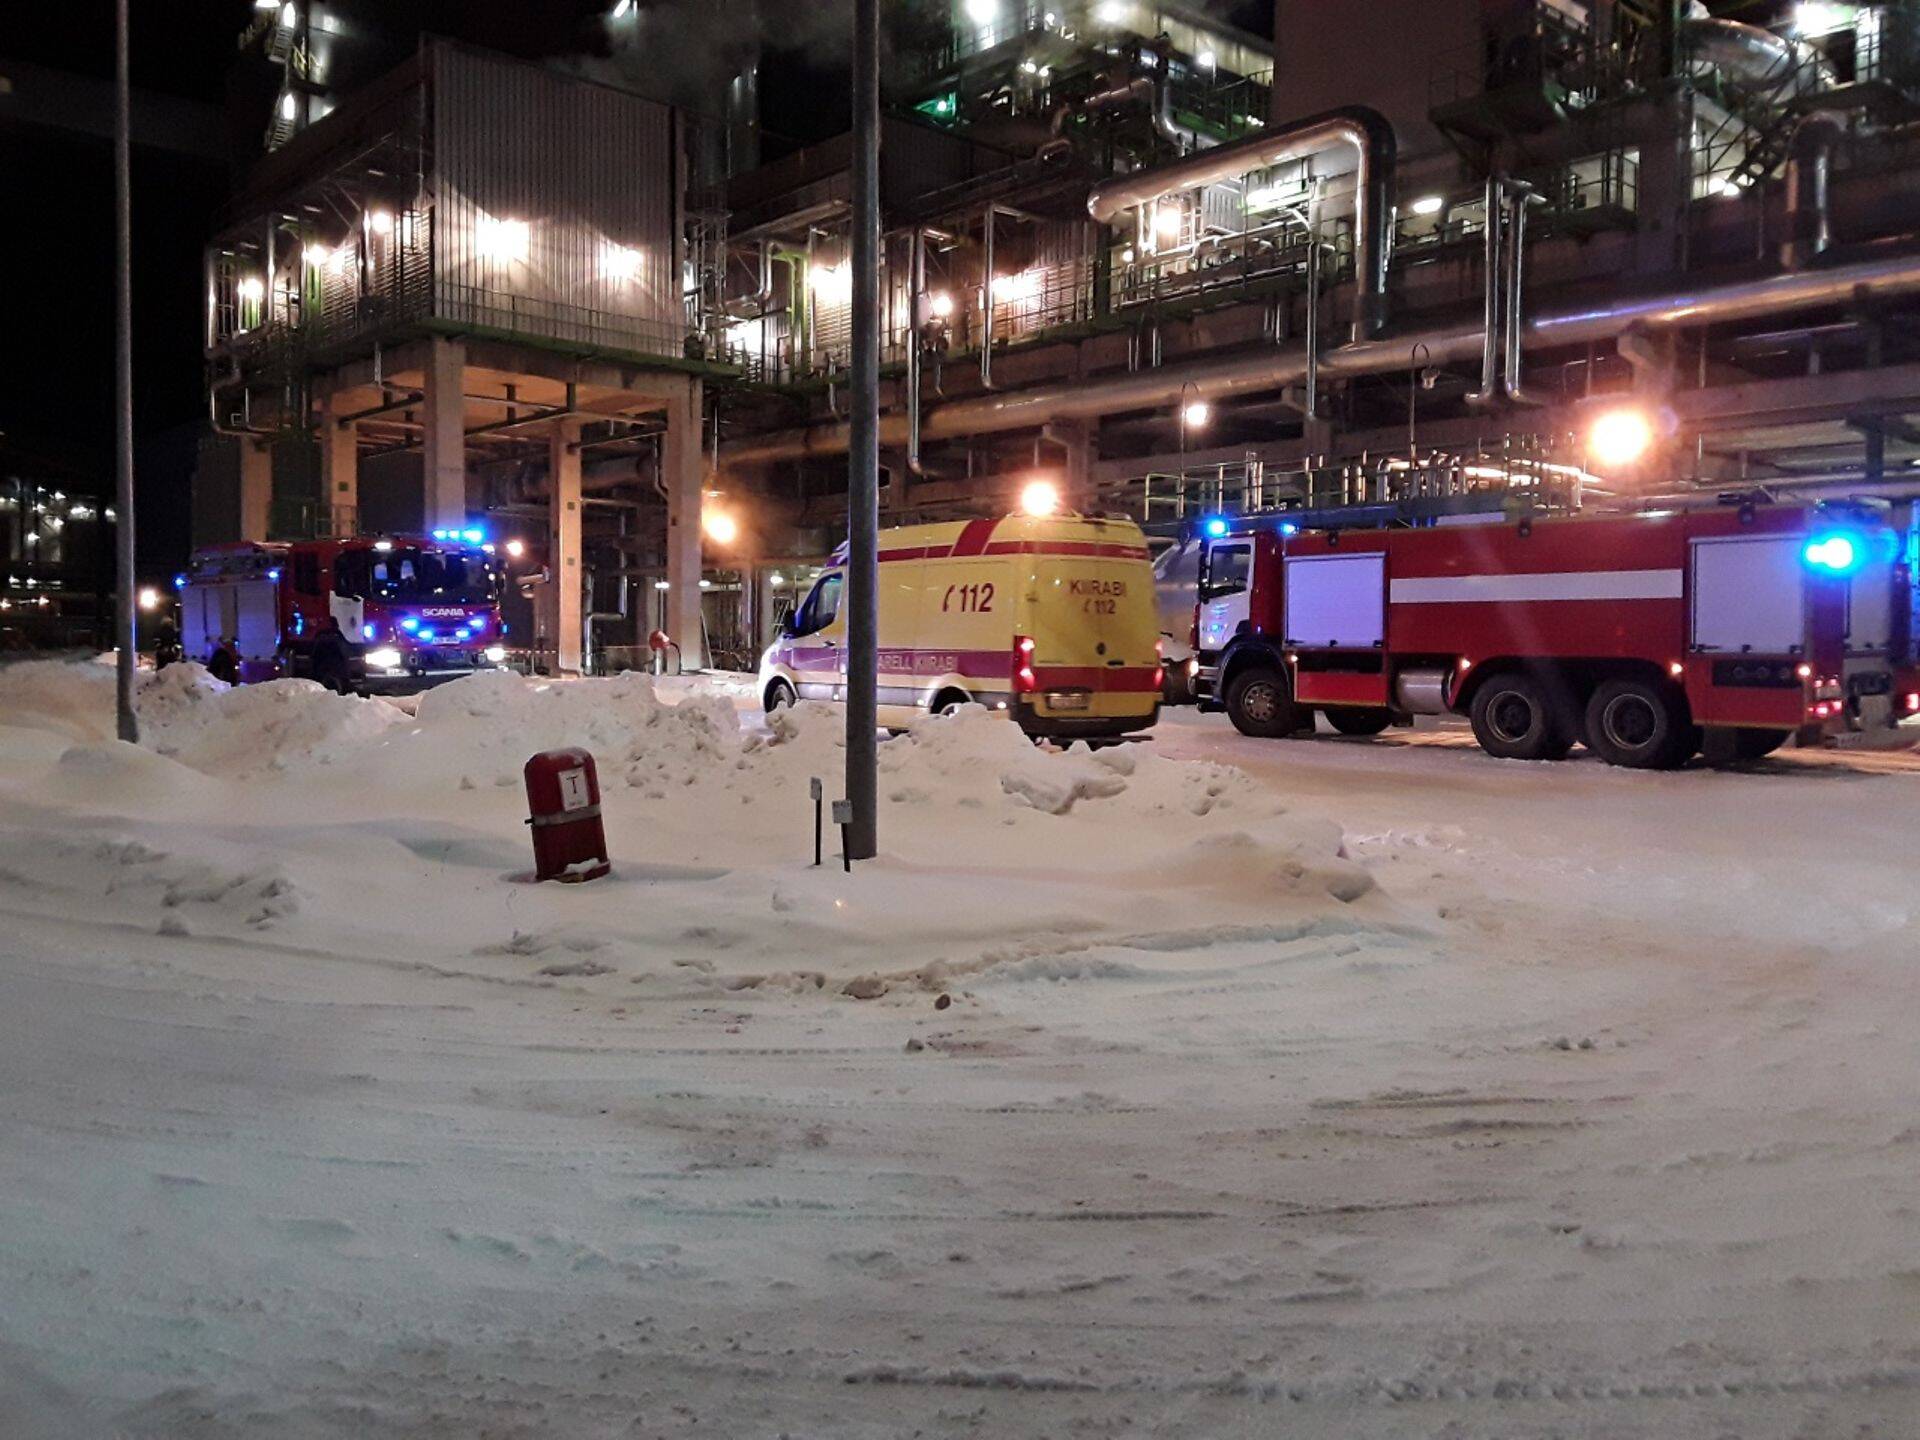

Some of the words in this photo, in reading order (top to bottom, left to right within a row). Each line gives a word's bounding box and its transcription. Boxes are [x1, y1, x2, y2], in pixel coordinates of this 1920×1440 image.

[960, 583, 994, 612] 112
[422, 608, 465, 617] SCANIA
[1094, 599, 1117, 615] 112
[877, 655, 912, 670] ARELL
